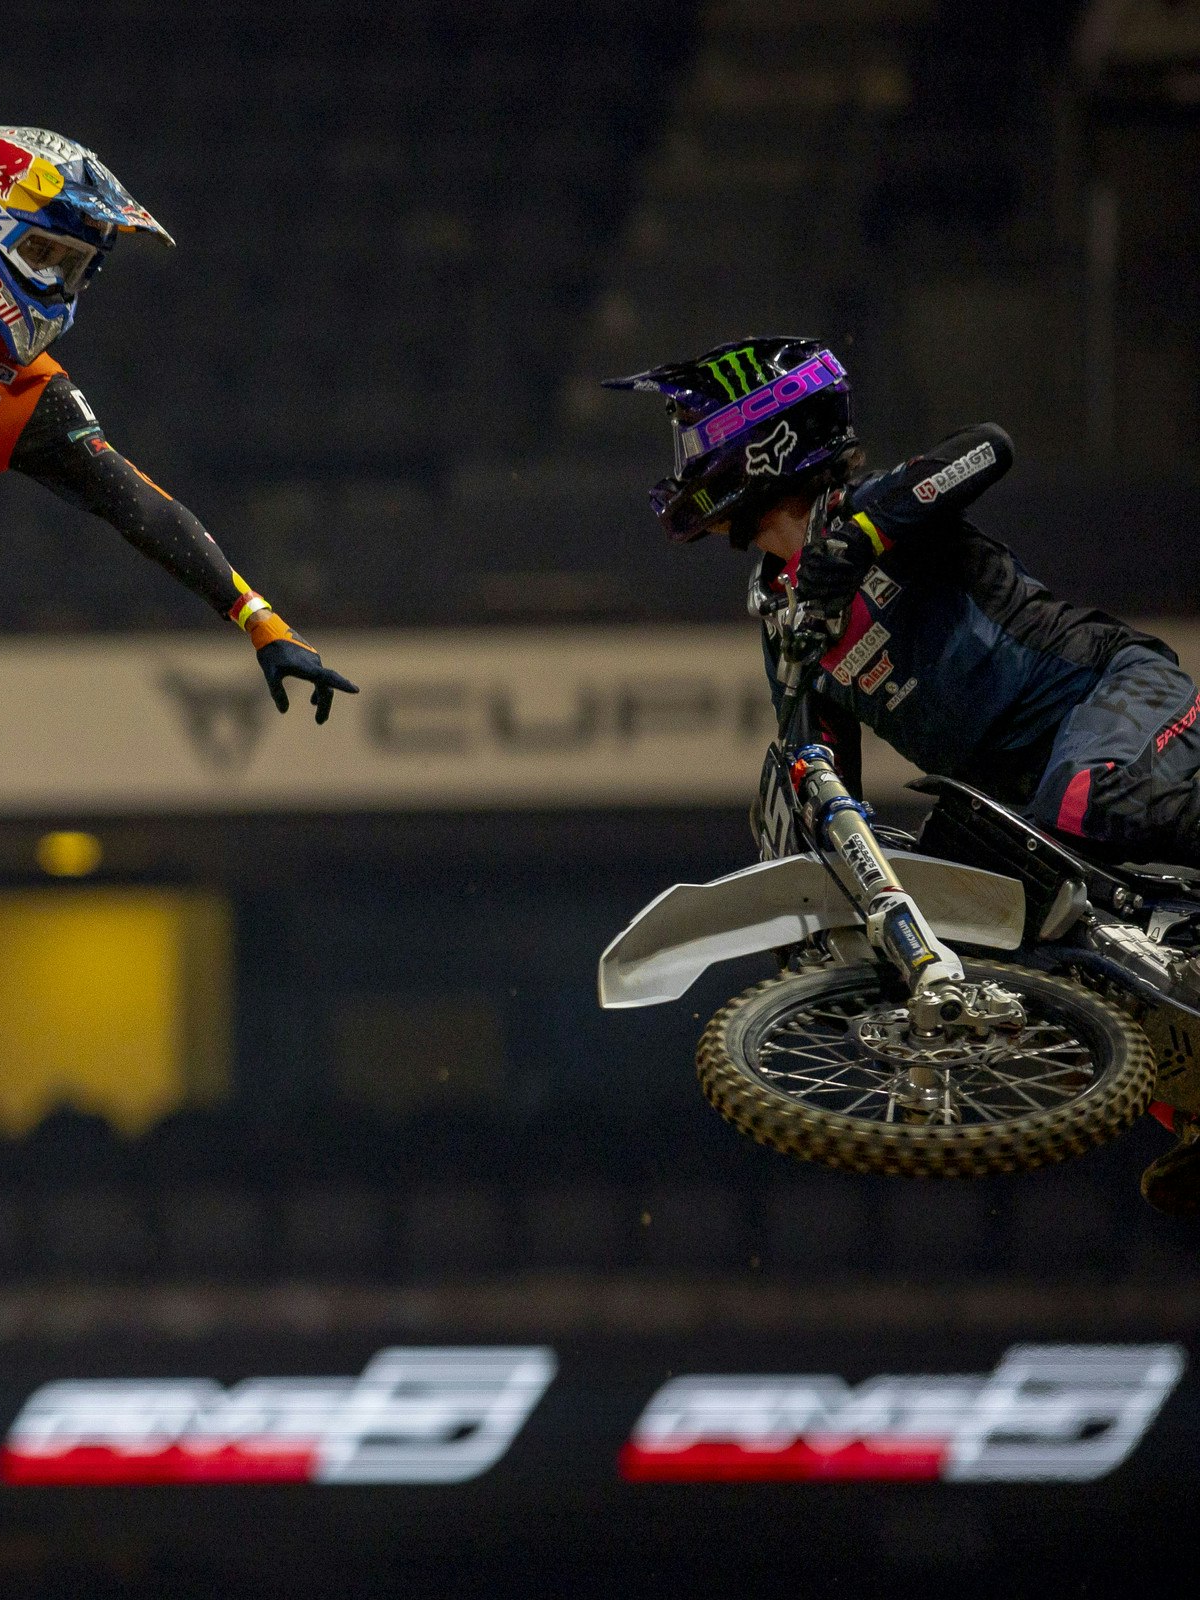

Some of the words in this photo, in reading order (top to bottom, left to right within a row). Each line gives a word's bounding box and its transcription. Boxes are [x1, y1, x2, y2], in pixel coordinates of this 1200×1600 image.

[934, 448, 994, 487] DESIGN
[843, 625, 886, 671] DESIGN
[898, 920, 920, 950] MICHELIN
